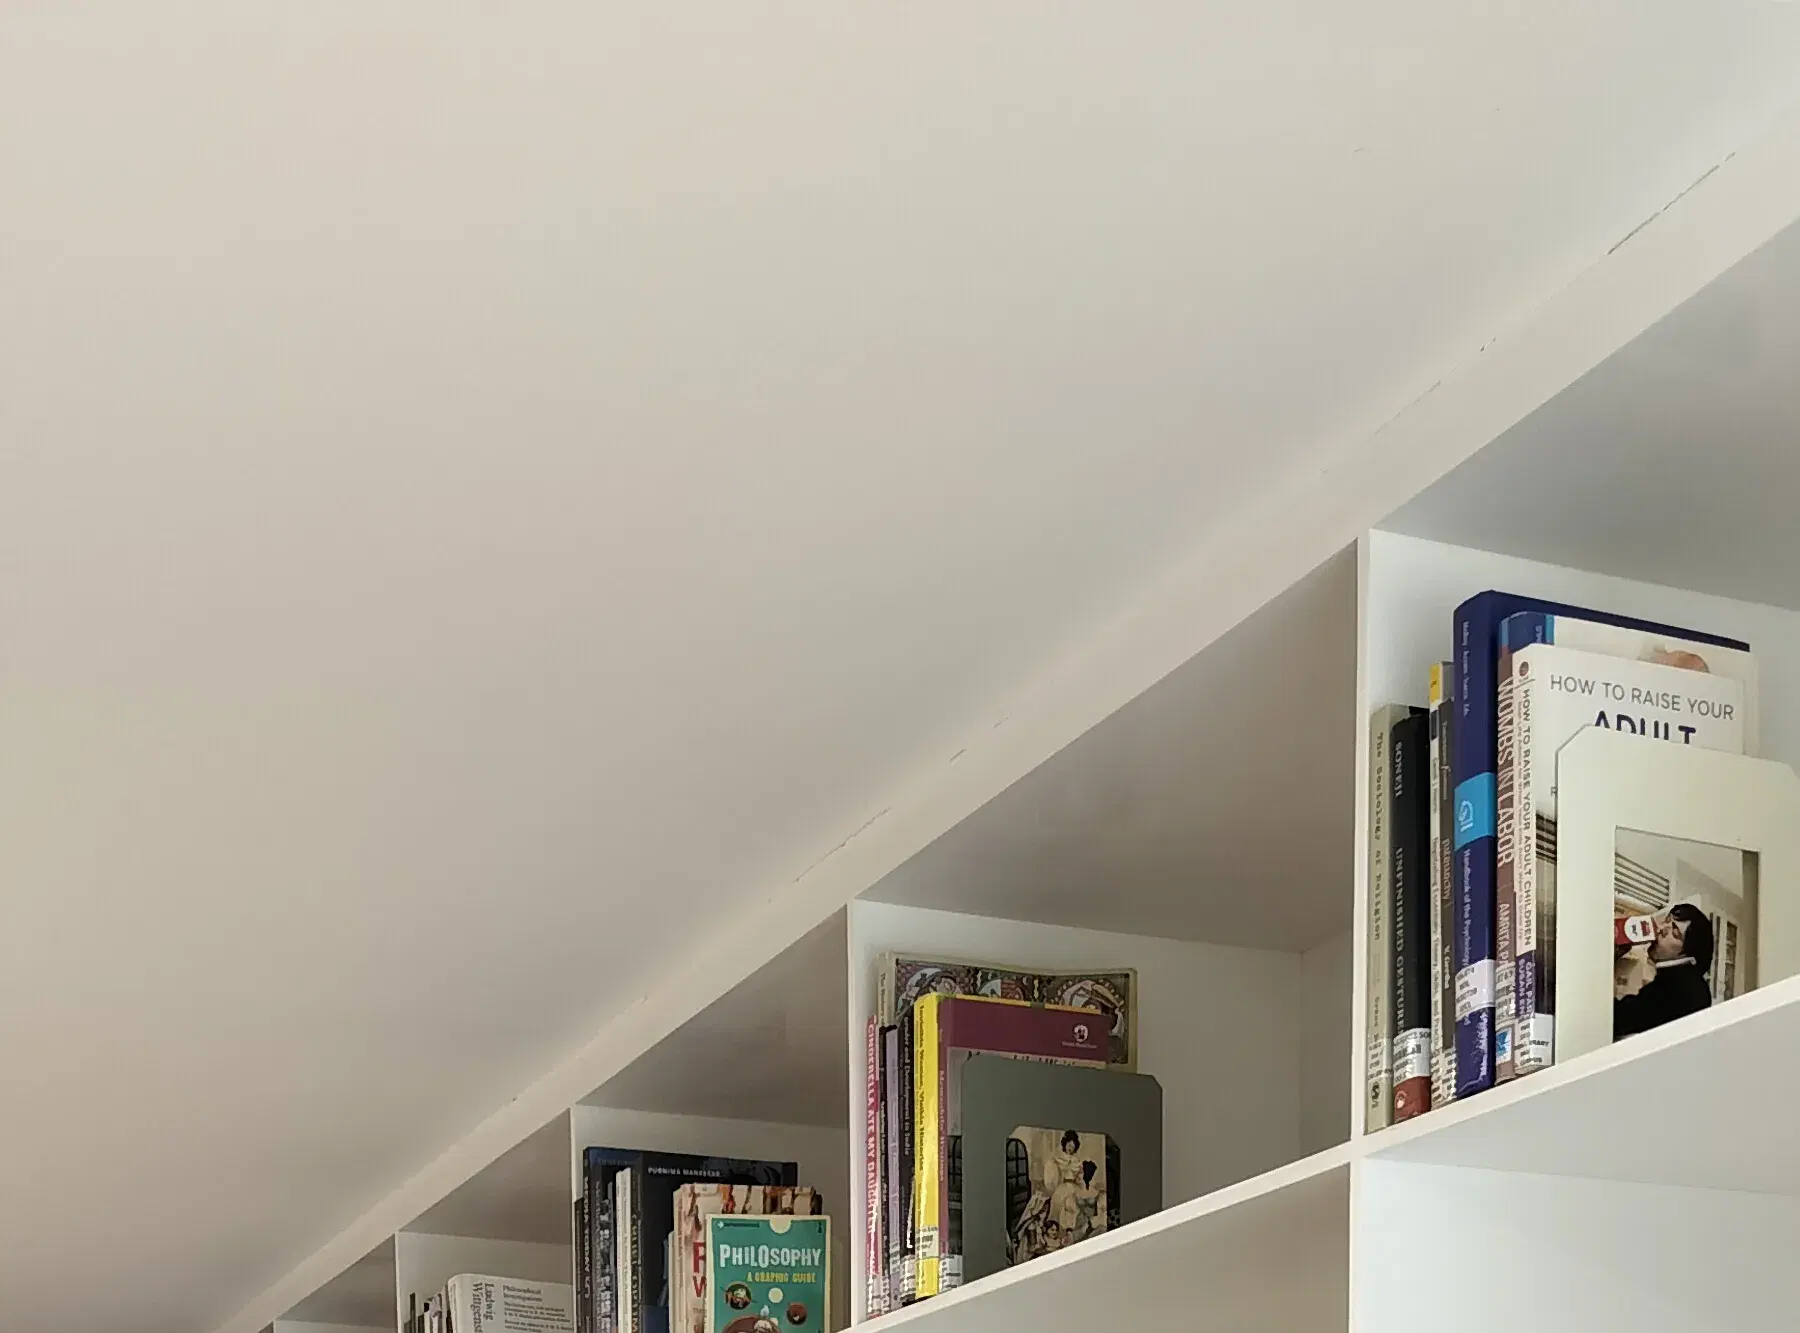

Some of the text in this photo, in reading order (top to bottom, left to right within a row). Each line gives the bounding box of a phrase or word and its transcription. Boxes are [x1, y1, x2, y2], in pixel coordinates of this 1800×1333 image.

[1550, 674, 1735, 721] HOW TO RAISE YOUR
[1394, 741, 1403, 798] SONEJI
[1497, 676, 1514, 868] WOMBS IN LABOR
[1522, 688, 1532, 947] HOW TO RAISE YOUR ADULT CHILDREN
[1395, 848, 1404, 951] UNFINISHED
[866, 1024, 876, 1107] CINDERELLA
[866, 1109, 875, 1132] ATE
[866, 1135, 875, 1160] MY
[719, 1244, 822, 1268] PHILOSOPHY
[484, 1283, 495, 1321] Ludwig
